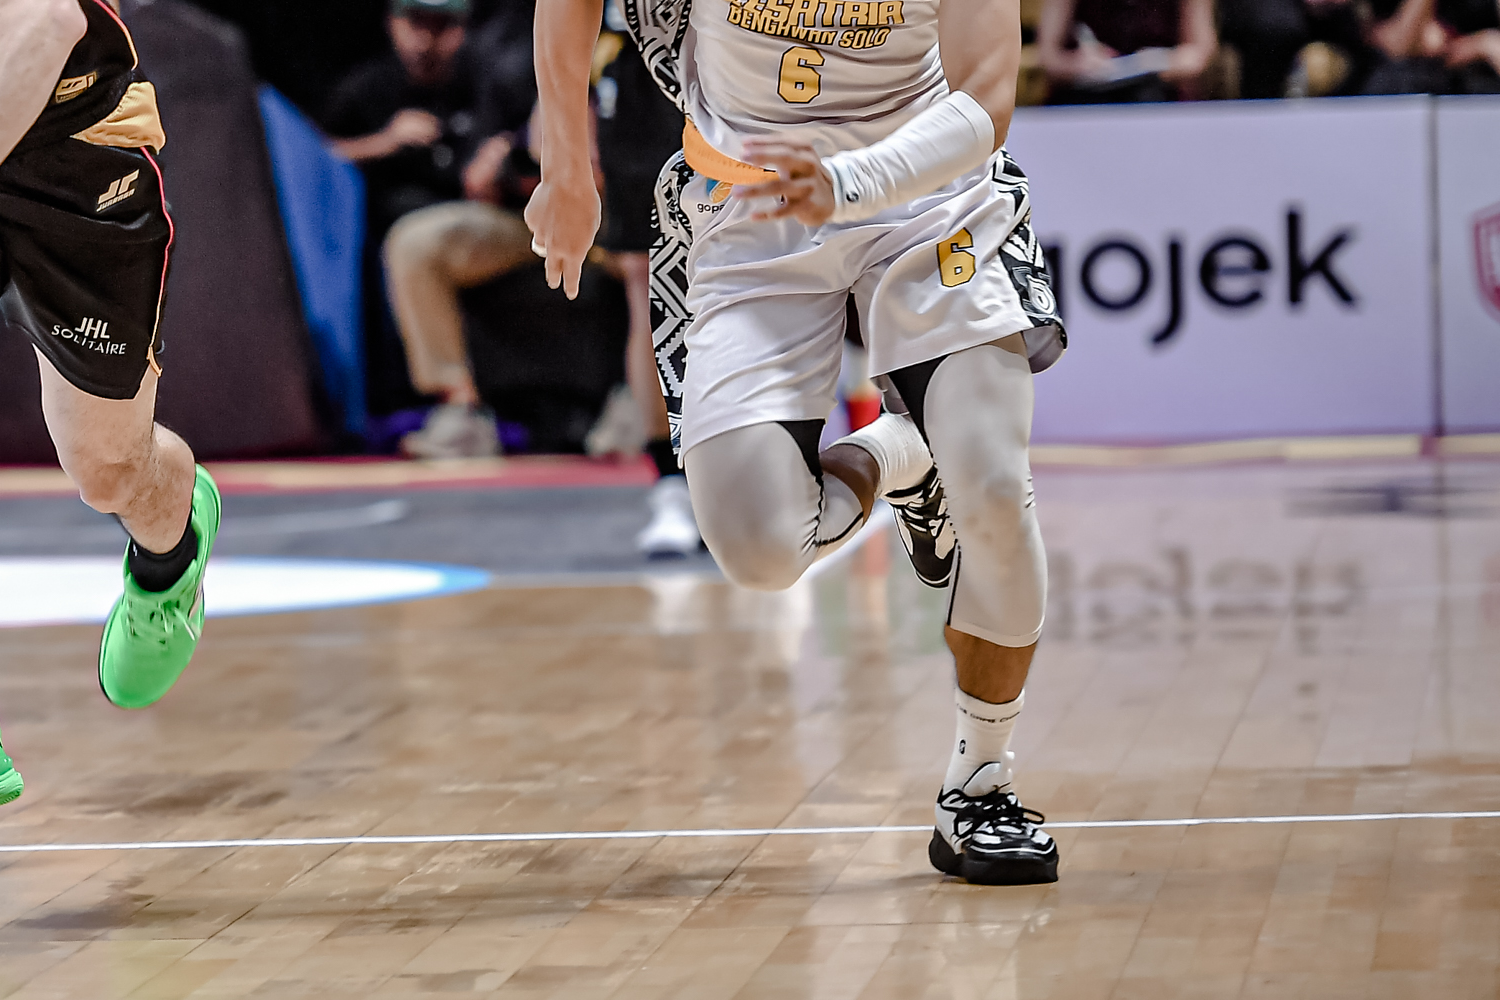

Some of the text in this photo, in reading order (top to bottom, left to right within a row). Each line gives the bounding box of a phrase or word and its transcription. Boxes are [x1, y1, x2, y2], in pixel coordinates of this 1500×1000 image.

[839, 26, 891, 50] SOLO
[777, 45, 826, 104] 6
[697, 203, 726, 214] gopa
[936, 227, 977, 288] 6
[51, 324, 127, 355] SOLITAIRE
[74, 316, 110, 339] JHL
